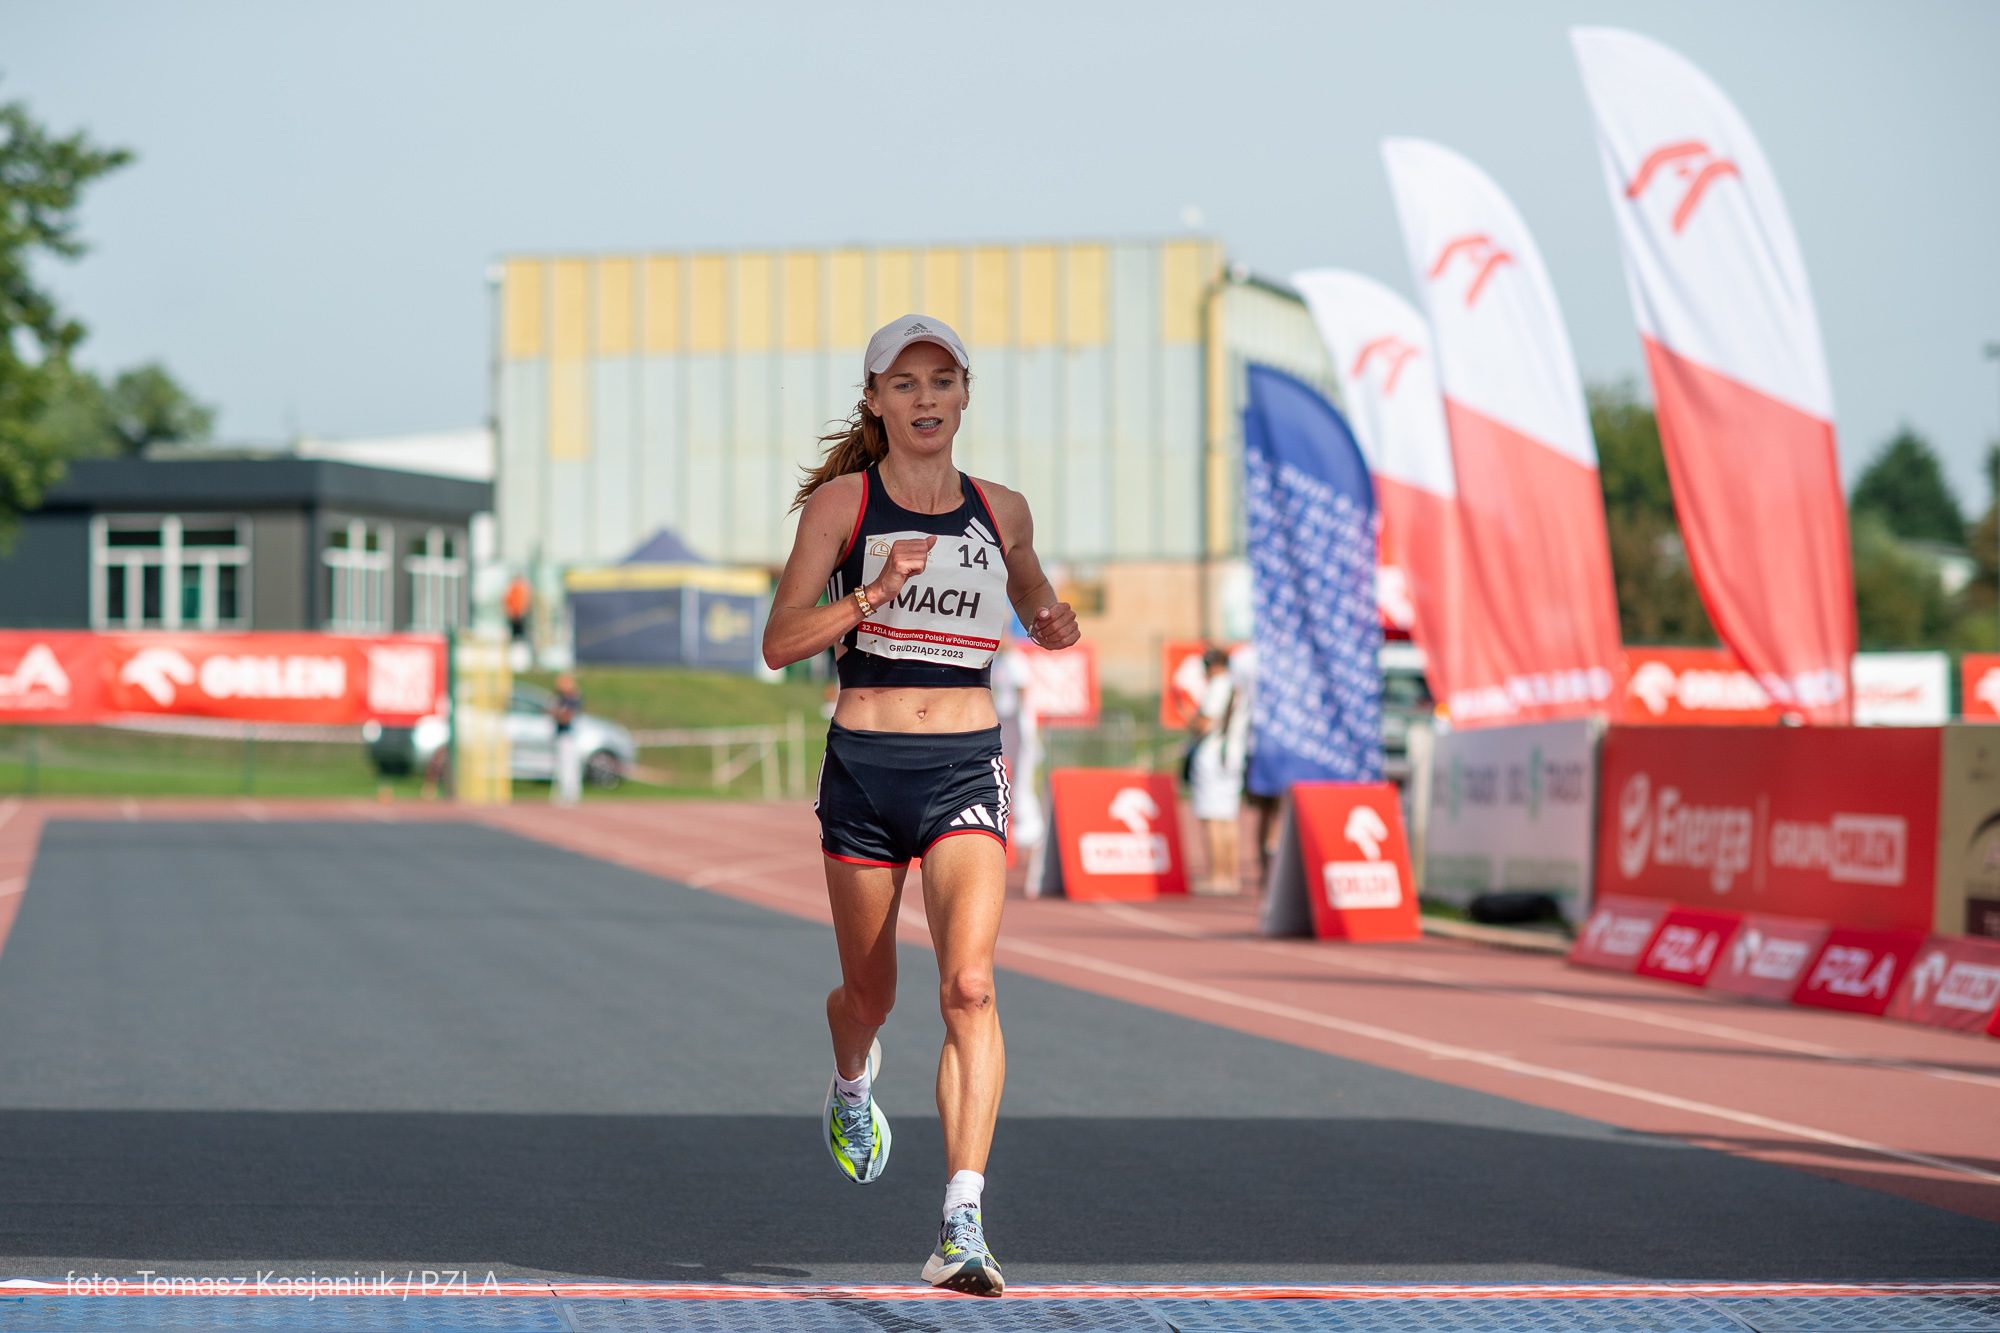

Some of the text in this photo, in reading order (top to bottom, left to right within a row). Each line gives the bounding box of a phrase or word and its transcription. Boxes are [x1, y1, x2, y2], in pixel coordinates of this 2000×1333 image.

[958, 544, 990, 570] 14
[889, 584, 981, 619] MACH
[862, 624, 873, 632] 32.
[873, 626, 887, 635] PZLA
[888, 630, 924, 640] Mistrzostwa
[925, 633, 945, 643] Polski
[889, 644, 964, 659] GRUDZIĄDZ 2023
[1655, 786, 1751, 893] Energa
